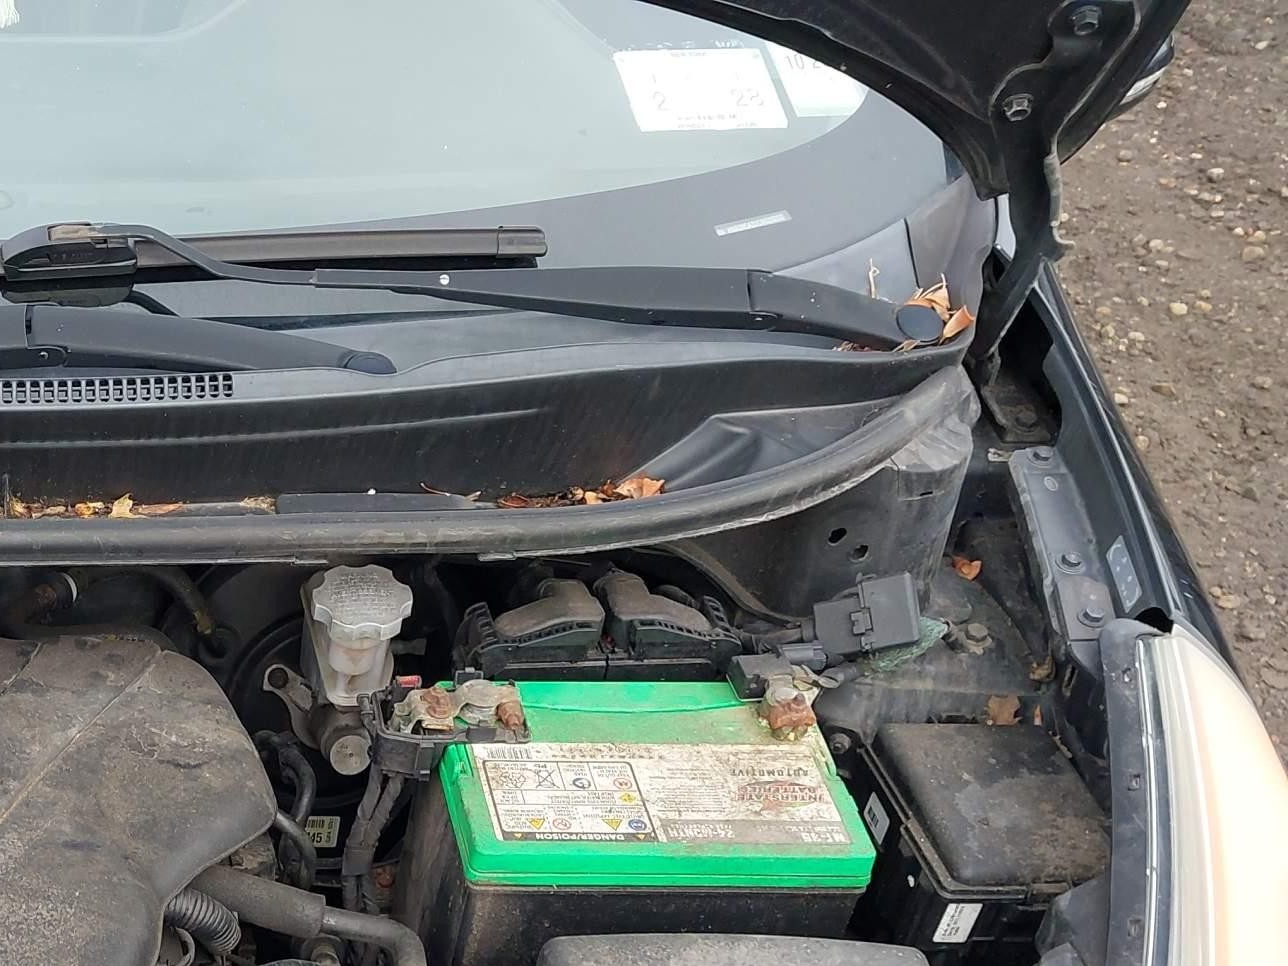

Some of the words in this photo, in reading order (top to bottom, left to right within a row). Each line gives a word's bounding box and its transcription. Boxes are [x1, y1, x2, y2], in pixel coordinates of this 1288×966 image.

[785, 54, 806, 70] 10
[731, 766, 809, 778] AUTOMOTIVE
[737, 785, 818, 794] BATTERIES
[735, 793, 824, 802] INTERSTATE
[534, 832, 626, 842] DANGER/POISON
